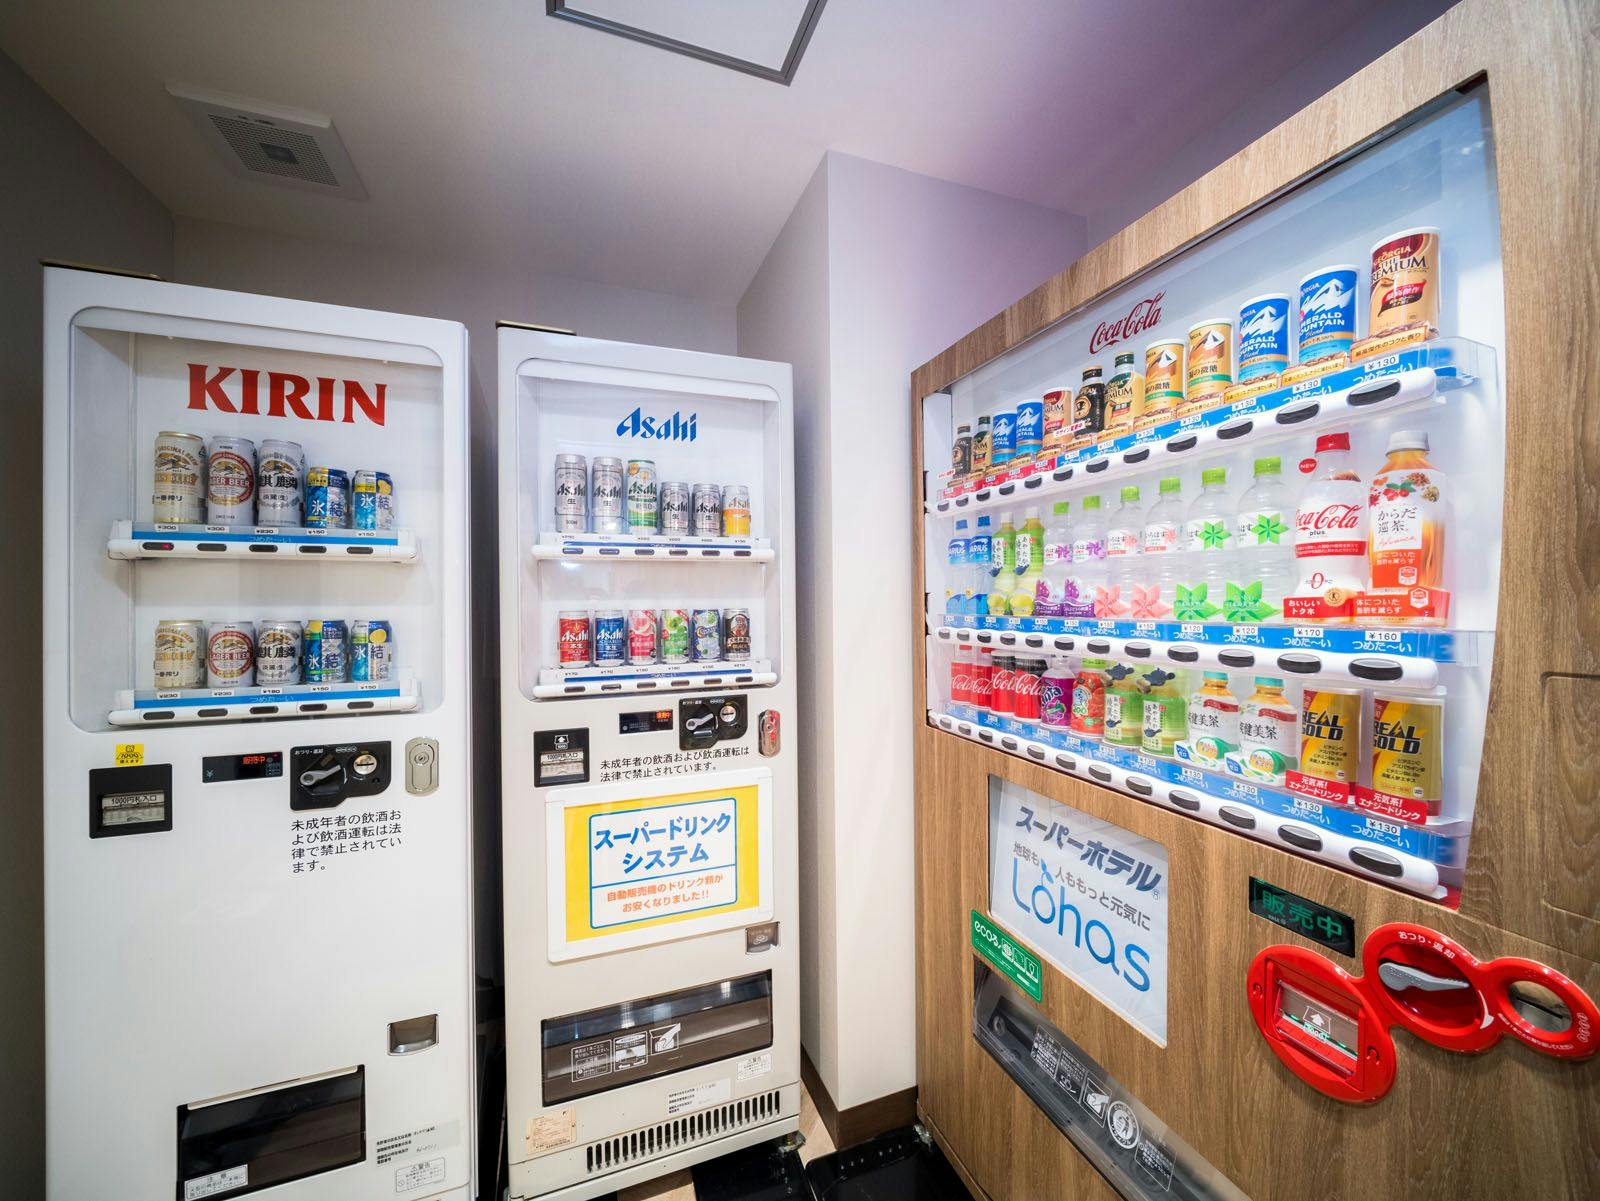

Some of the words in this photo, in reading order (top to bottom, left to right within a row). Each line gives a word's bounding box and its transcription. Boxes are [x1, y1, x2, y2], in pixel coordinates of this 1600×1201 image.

[1368, 356, 1396, 370] ¥130
[1295, 380, 1319, 391] ¥130
[187, 363, 388, 427] KIRIN
[616, 407, 697, 442] Asahi
[360, 493, 390, 510] 氷結
[664, 501, 688, 513] Asahi
[1378, 507, 1418, 520] からだ
[1310, 529, 1326, 537] plus
[1377, 520, 1408, 534] 巡茶
[1288, 600, 1321, 608] おいしい
[562, 629, 589, 641] Asahi
[1235, 627, 1256, 635] ¥120
[1297, 629, 1321, 637] ¥170
[1369, 632, 1397, 641] ¥160
[309, 653, 339, 669] 氷結
[355, 645, 385, 660] 氷結
[1301, 711, 1344, 728] REAL
[1373, 721, 1421, 740] REAL
[600, 746, 750, 770] 未成年者の飲酒および飲酒運転は
[600, 762, 717, 782] 法律で禁止されています。
[1184, 769, 1201, 779] ¥130
[1235, 784, 1256, 794] ¥130
[1289, 782, 1344, 801] エナジードリンク
[1295, 800, 1320, 812] ¥130
[1359, 798, 1421, 820] エナジードリンク
[291, 809, 402, 831] 未成年者の飲酒お
[1368, 819, 1398, 833] ¥130
[291, 823, 402, 846] よび飲酒運転は法
[593, 813, 731, 851] スーパードリンク
[291, 836, 402, 860] 律で禁止されてい
[1016, 806, 1162, 891] スーパーホテル
[292, 860, 326, 873] ます。
[622, 843, 709, 874] システム
[607, 873, 723, 902] 自動販売機のドリンク類が
[1013, 840, 1040, 866] 地球も
[1055, 866, 1151, 932] 人ももっと元気に
[1263, 890, 1343, 938] 販売中
[1013, 857, 1150, 992] Lohas
